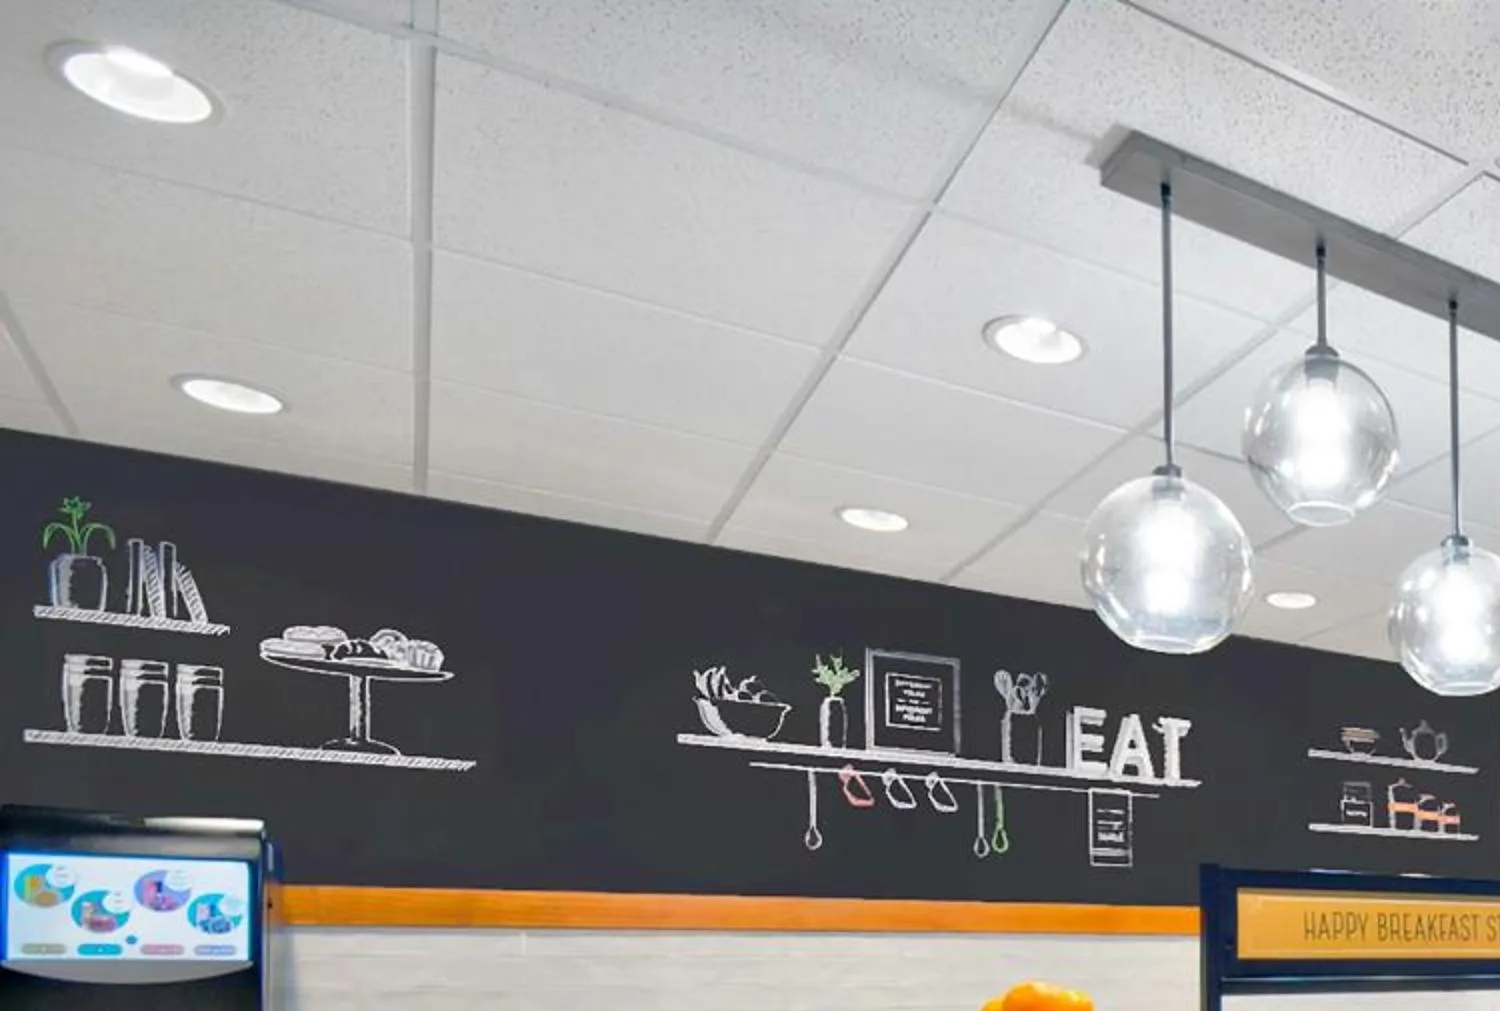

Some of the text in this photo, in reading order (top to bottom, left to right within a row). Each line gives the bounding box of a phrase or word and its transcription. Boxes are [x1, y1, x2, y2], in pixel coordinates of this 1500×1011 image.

[1065, 705, 1192, 780] EAT
[1303, 911, 1370, 940] HAPPY
[1377, 911, 1479, 943] BREAKFAST
